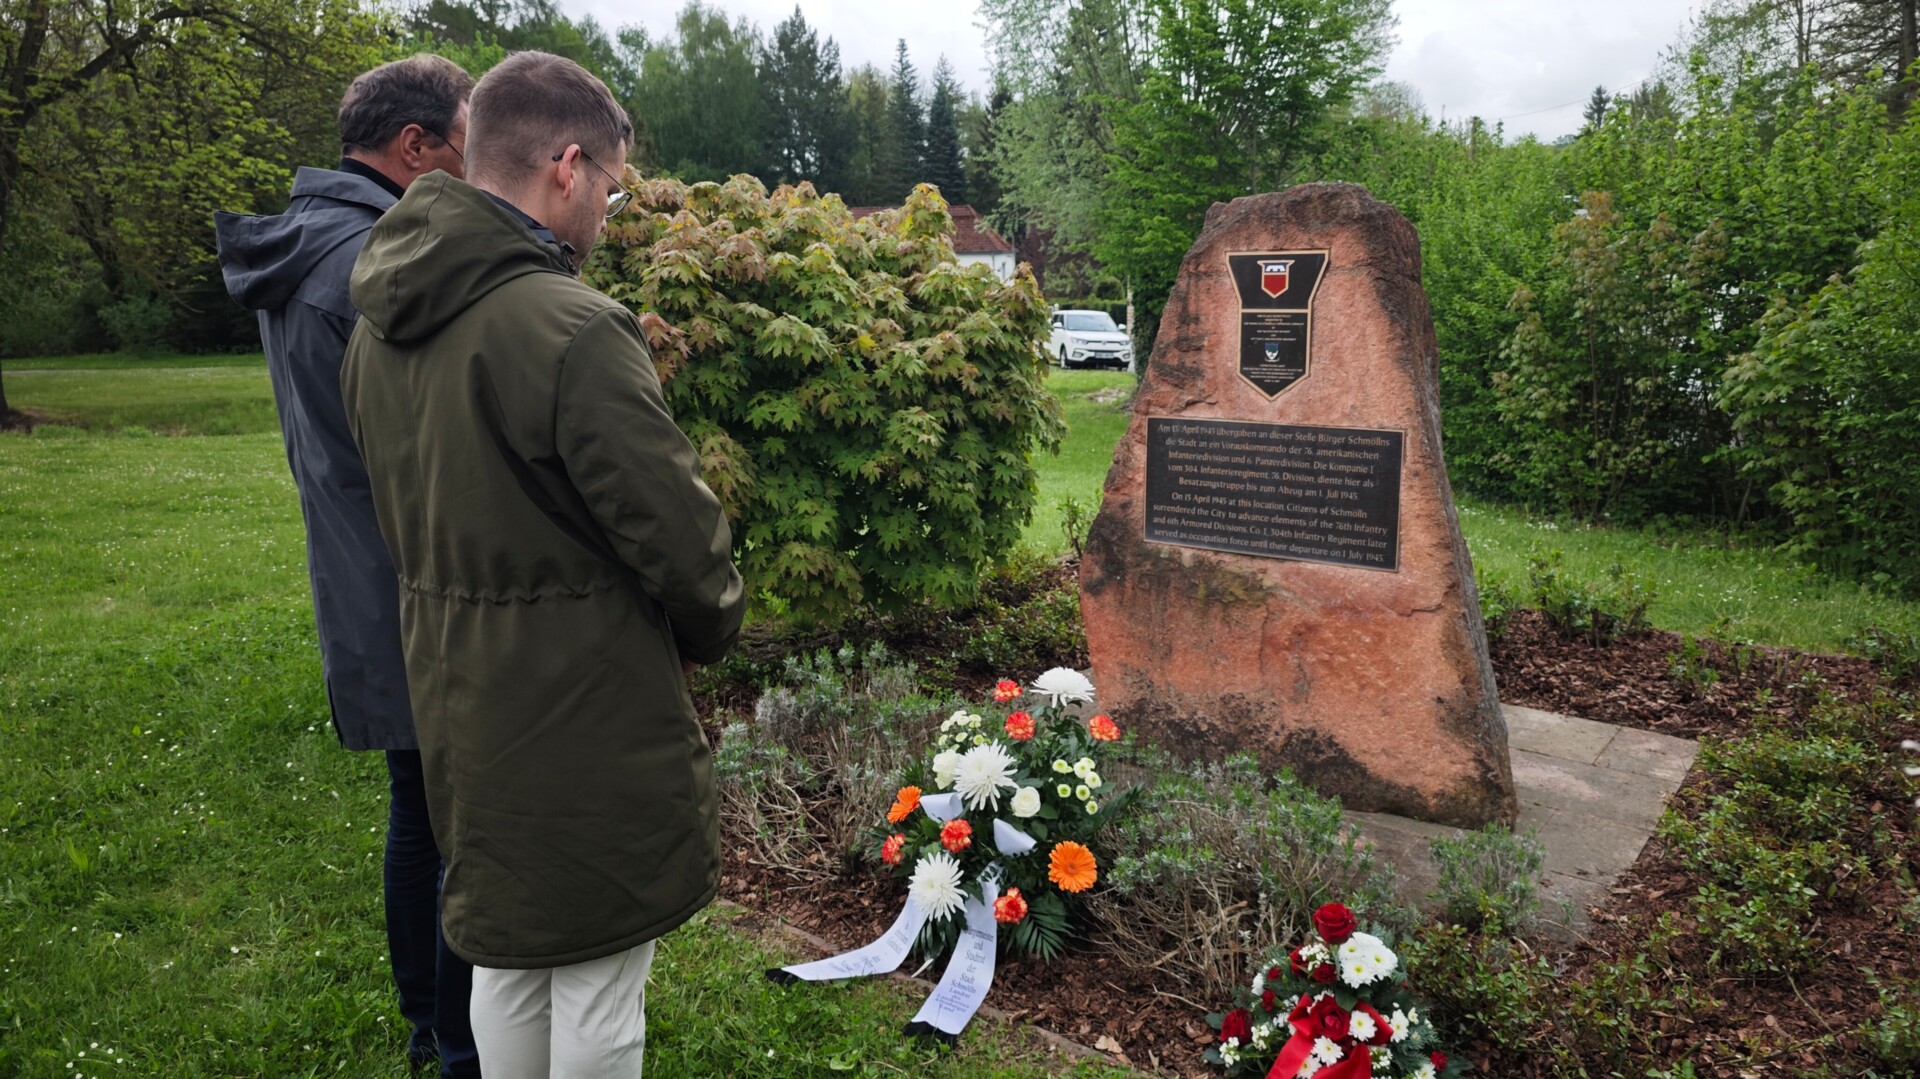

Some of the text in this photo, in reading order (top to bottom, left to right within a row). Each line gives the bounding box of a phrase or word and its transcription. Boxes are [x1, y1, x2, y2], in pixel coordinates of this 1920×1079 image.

[1158, 424, 1170, 433] Am
[1181, 426, 1199, 435] April
[1200, 427, 1216, 436] 1945
[1216, 428, 1257, 439] übergaben
[1269, 430, 1292, 440] dieser
[1295, 432, 1316, 442] Stelle
[1318, 433, 1345, 445] Bürger
[1348, 435, 1390, 447] Schmöllns
[1165, 437, 1176, 446] die
[1178, 438, 1197, 447] Stadt
[1209, 440, 1220, 449] ein
[1221, 441, 1287, 453] Vorauskommando
[1289, 445, 1302, 454] der
[1316, 448, 1379, 460] amerikanischen
[1168, 450, 1230, 462] Infanteriedivision
[1231, 455, 1245, 464] und
[1313, 461, 1327, 470] Die
[1329, 462, 1368, 473] Kompanie
[1168, 464, 1182, 472] vom
[1318, 475, 1342, 485] diente
[1345, 477, 1360, 487] hier
[1363, 479, 1374, 488] als
[1179, 477, 1244, 491] Besatzungstruppe
[1246, 482, 1257, 491] bis
[1259, 485, 1275, 493] zum
[1278, 486, 1302, 497] Abzug
[1326, 489, 1338, 498] Juli
[1171, 492, 1183, 500] On
[1193, 494, 1210, 504] April
[1212, 496, 1227, 505] 1945
[1238, 499, 1252, 507] this
[1287, 503, 1317, 513] Citizens
[1320, 505, 1328, 514] of
[1330, 507, 1367, 518] Schmölln
[1153, 504, 1195, 514] surrendered
[1197, 506, 1209, 515] the
[1211, 509, 1226, 519] City
[1238, 512, 1269, 522] advance
[1271, 515, 1307, 526] elements
[1309, 519, 1318, 527] of
[1320, 520, 1333, 529] the
[1335, 521, 1352, 531] 76th
[1354, 524, 1388, 536] Infantry
[1153, 515, 1165, 523] and
[1167, 517, 1178, 525] 6th
[1180, 519, 1212, 529] Armored
[1294, 530, 1325, 543] Infantry
[1328, 534, 1365, 546] Regiment
[1368, 538, 1388, 548] later
[1154, 529, 1178, 538] served
[1188, 533, 1228, 544] occupation
[1229, 537, 1249, 546] force
[1250, 539, 1268, 549] until
[1269, 541, 1287, 551] their
[1289, 544, 1328, 556] departure
[1330, 549, 1340, 557] on
[1348, 550, 1364, 561] July
